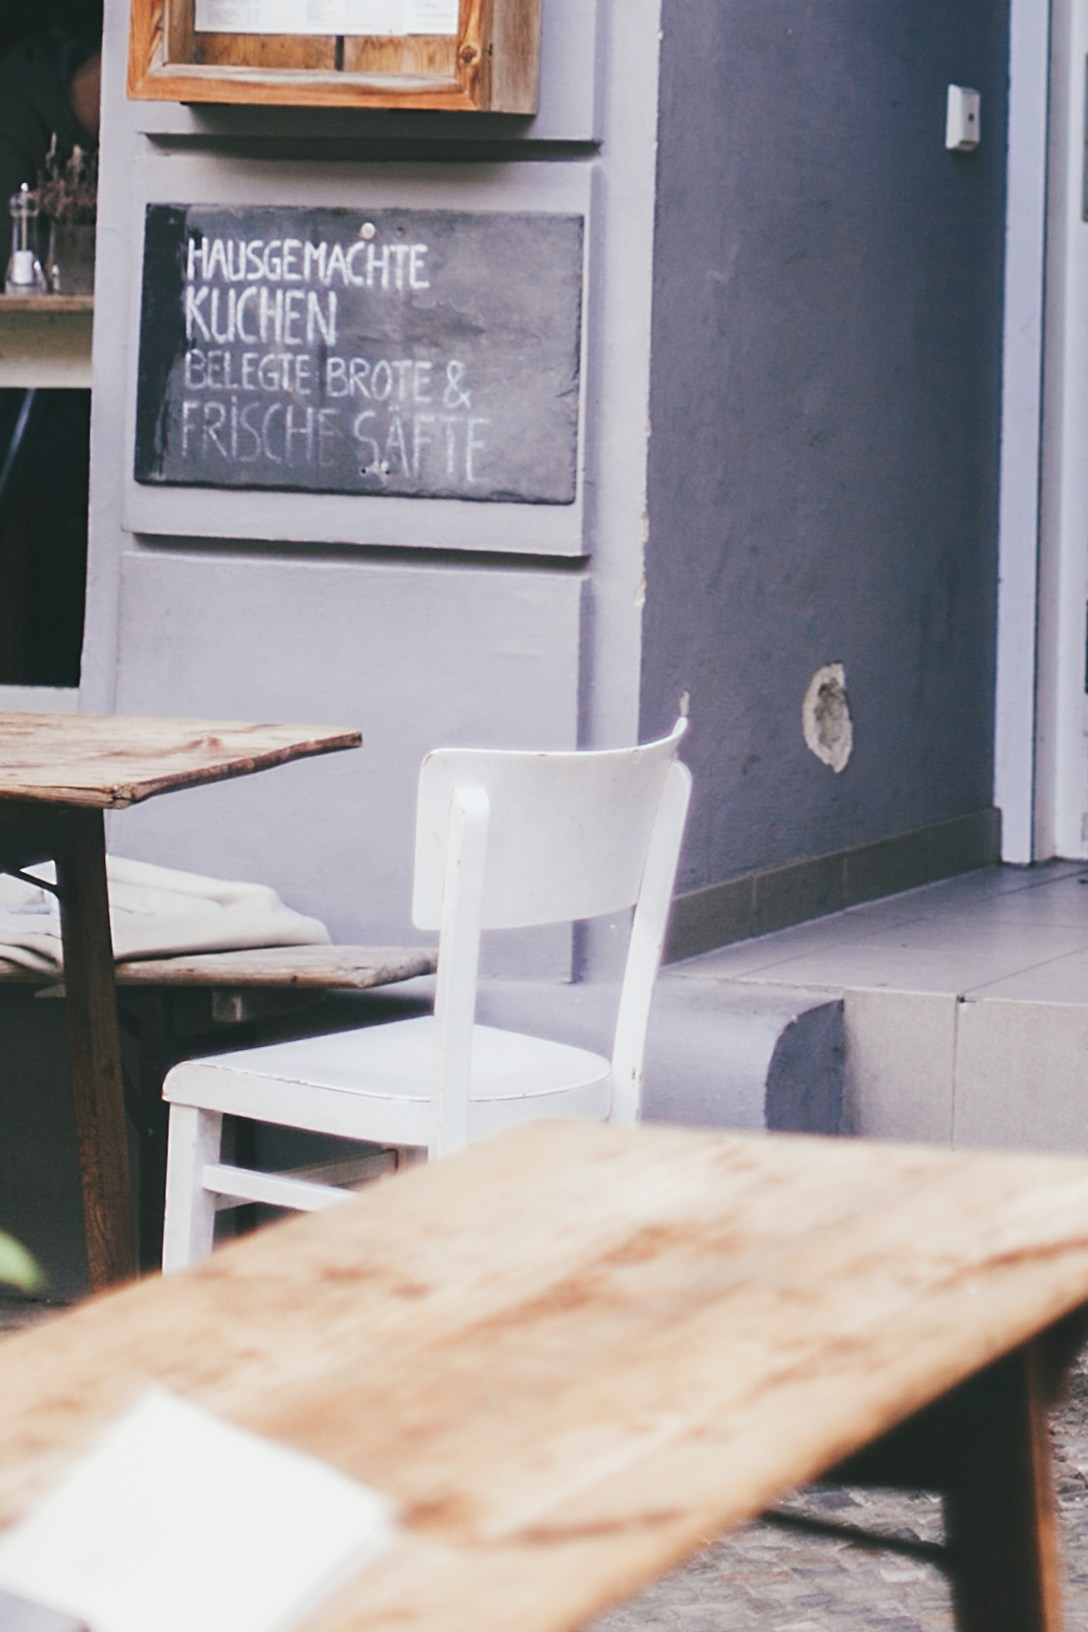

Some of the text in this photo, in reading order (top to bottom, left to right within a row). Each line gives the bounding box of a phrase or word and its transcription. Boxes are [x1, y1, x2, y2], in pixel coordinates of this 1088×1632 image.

[186, 238, 430, 290] HAUSGEMACHTE
[185, 286, 337, 346] KUCHEN
[184, 349, 472, 408] BELEGTE BROTE &
[182, 396, 491, 483] FRISCHE SÄFTE
